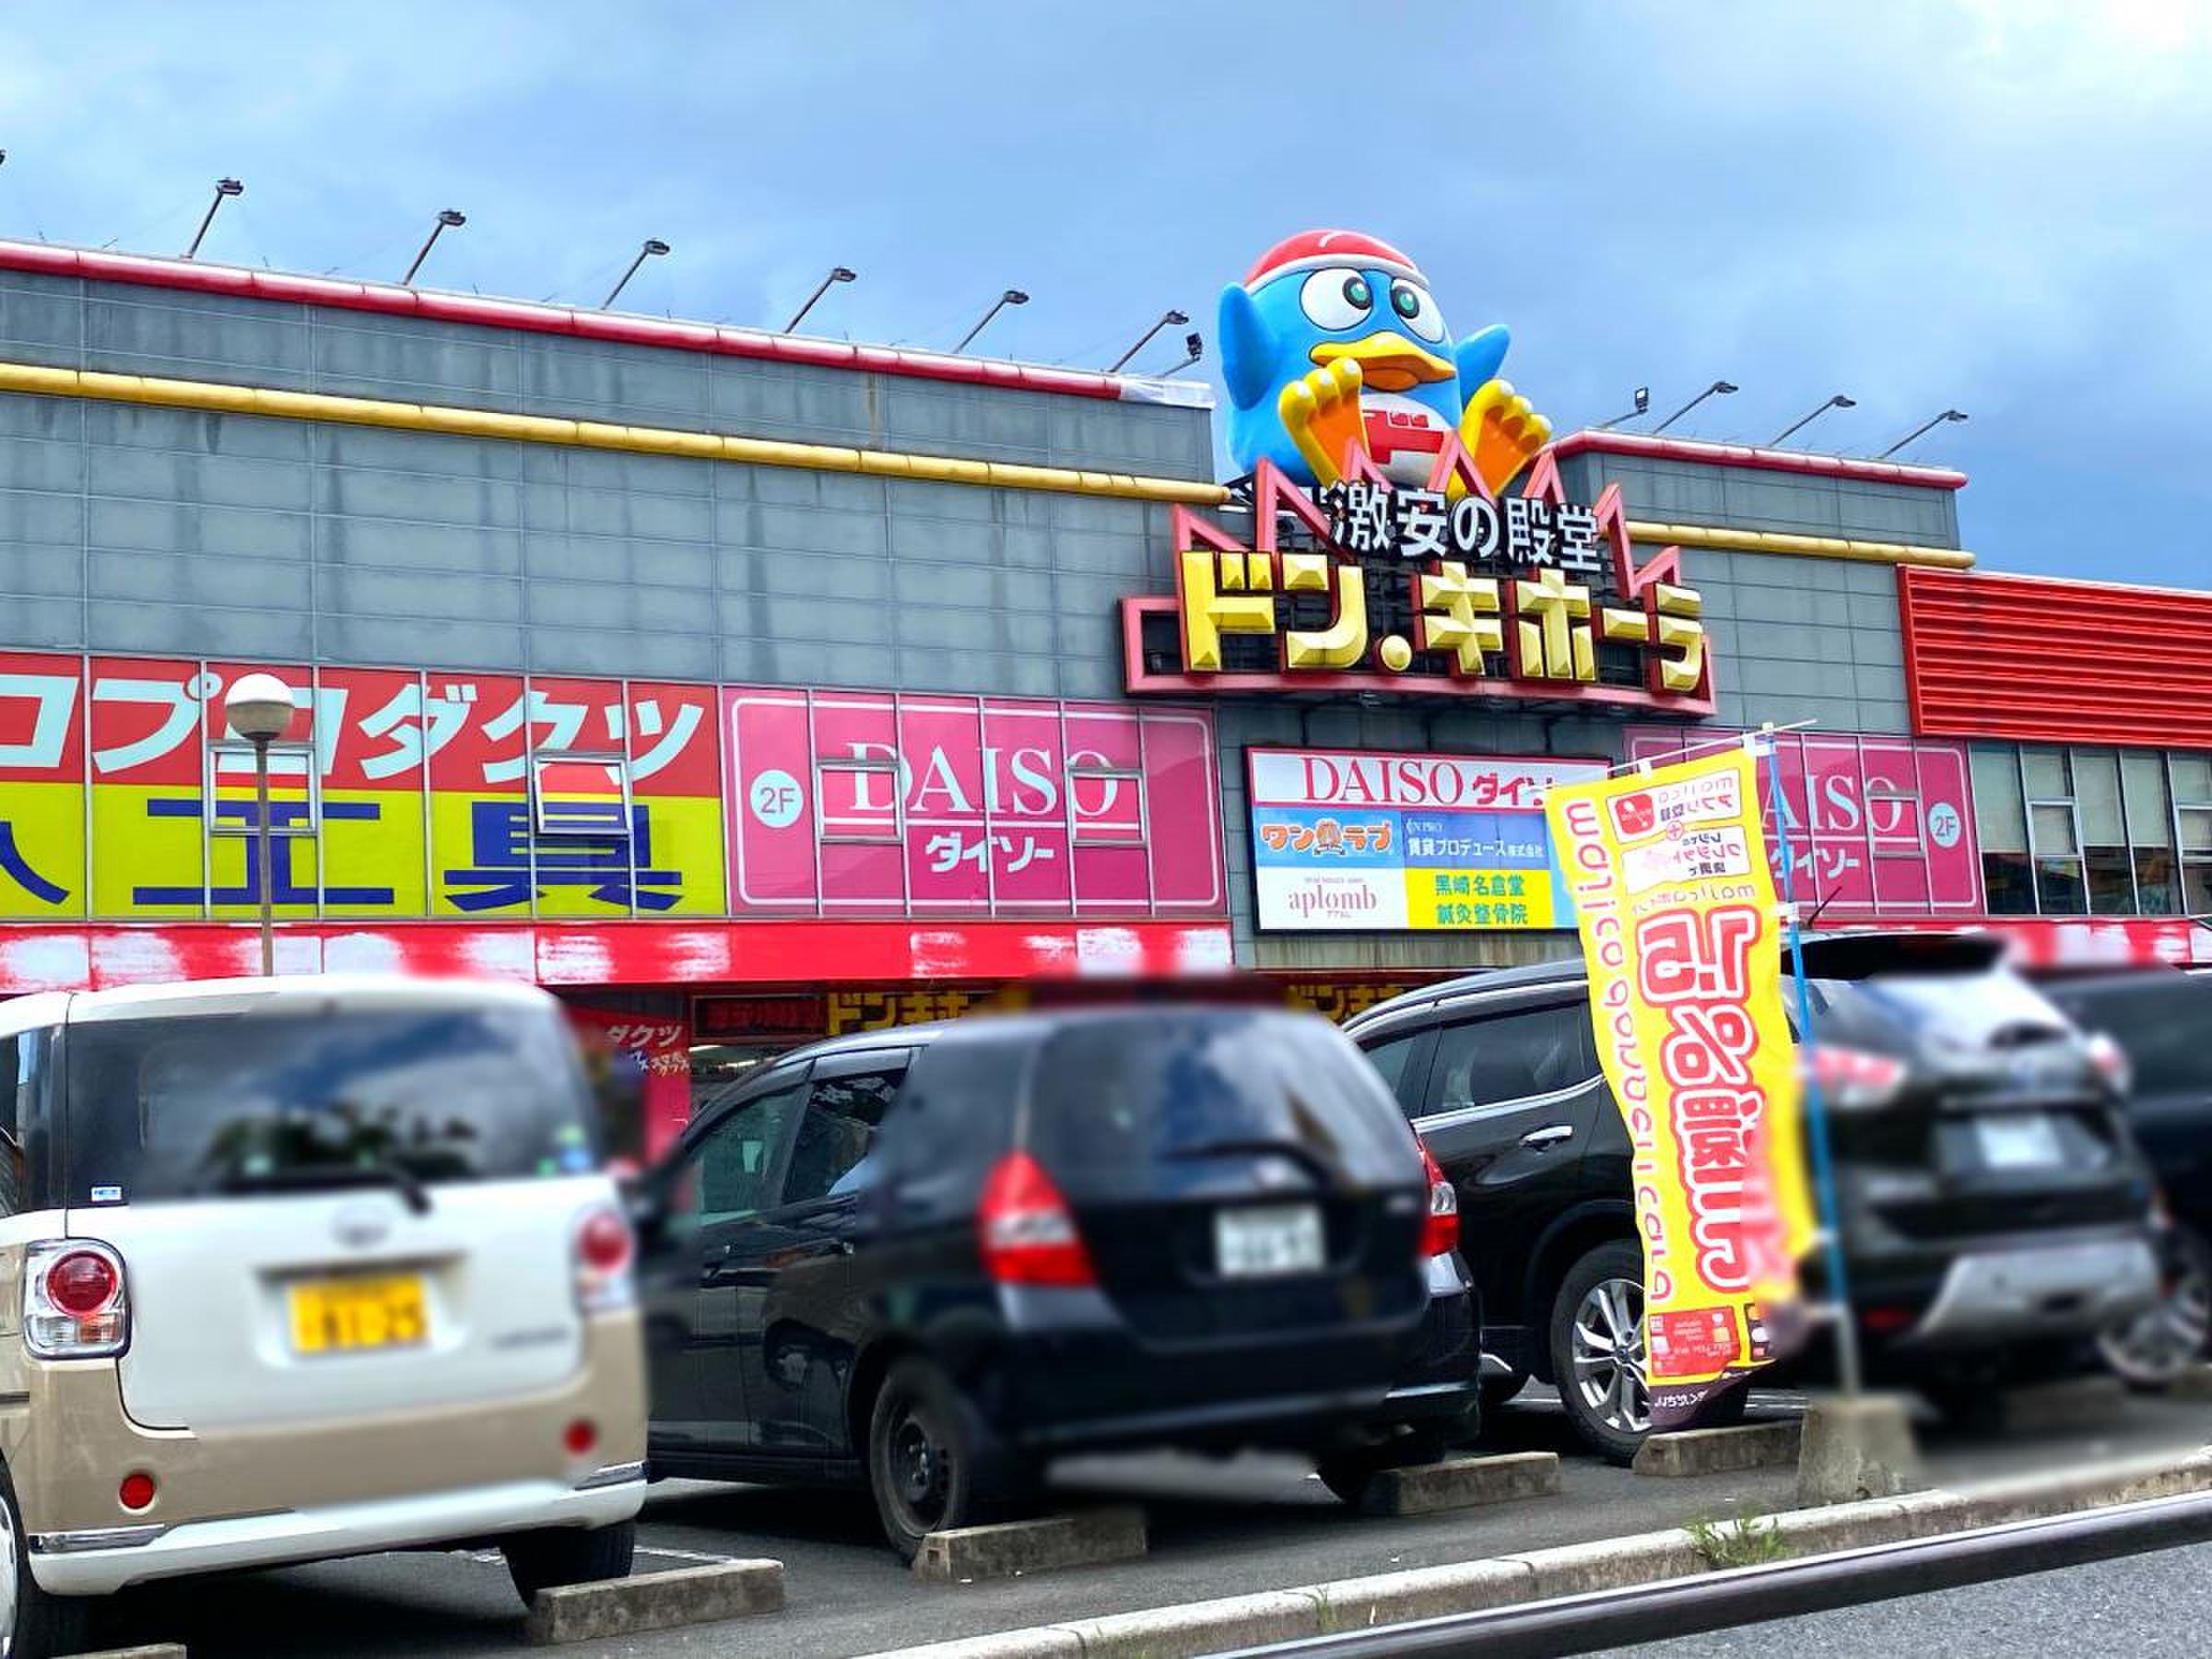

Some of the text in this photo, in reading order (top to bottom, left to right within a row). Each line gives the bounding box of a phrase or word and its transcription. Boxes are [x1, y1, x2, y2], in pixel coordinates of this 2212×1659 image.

[1335, 483, 1602, 571] 激安の殿堂
[845, 742, 1120, 817] DAISO
[1301, 757, 1464, 805] DAISO
[1472, 772, 1554, 806] ダイ
[759, 787, 795, 815] 2F
[1761, 772, 1901, 832] AISO
[1934, 814, 1957, 838] 2F
[926, 831, 1054, 873] ダイソー
[1288, 884, 1377, 918] aplomb
